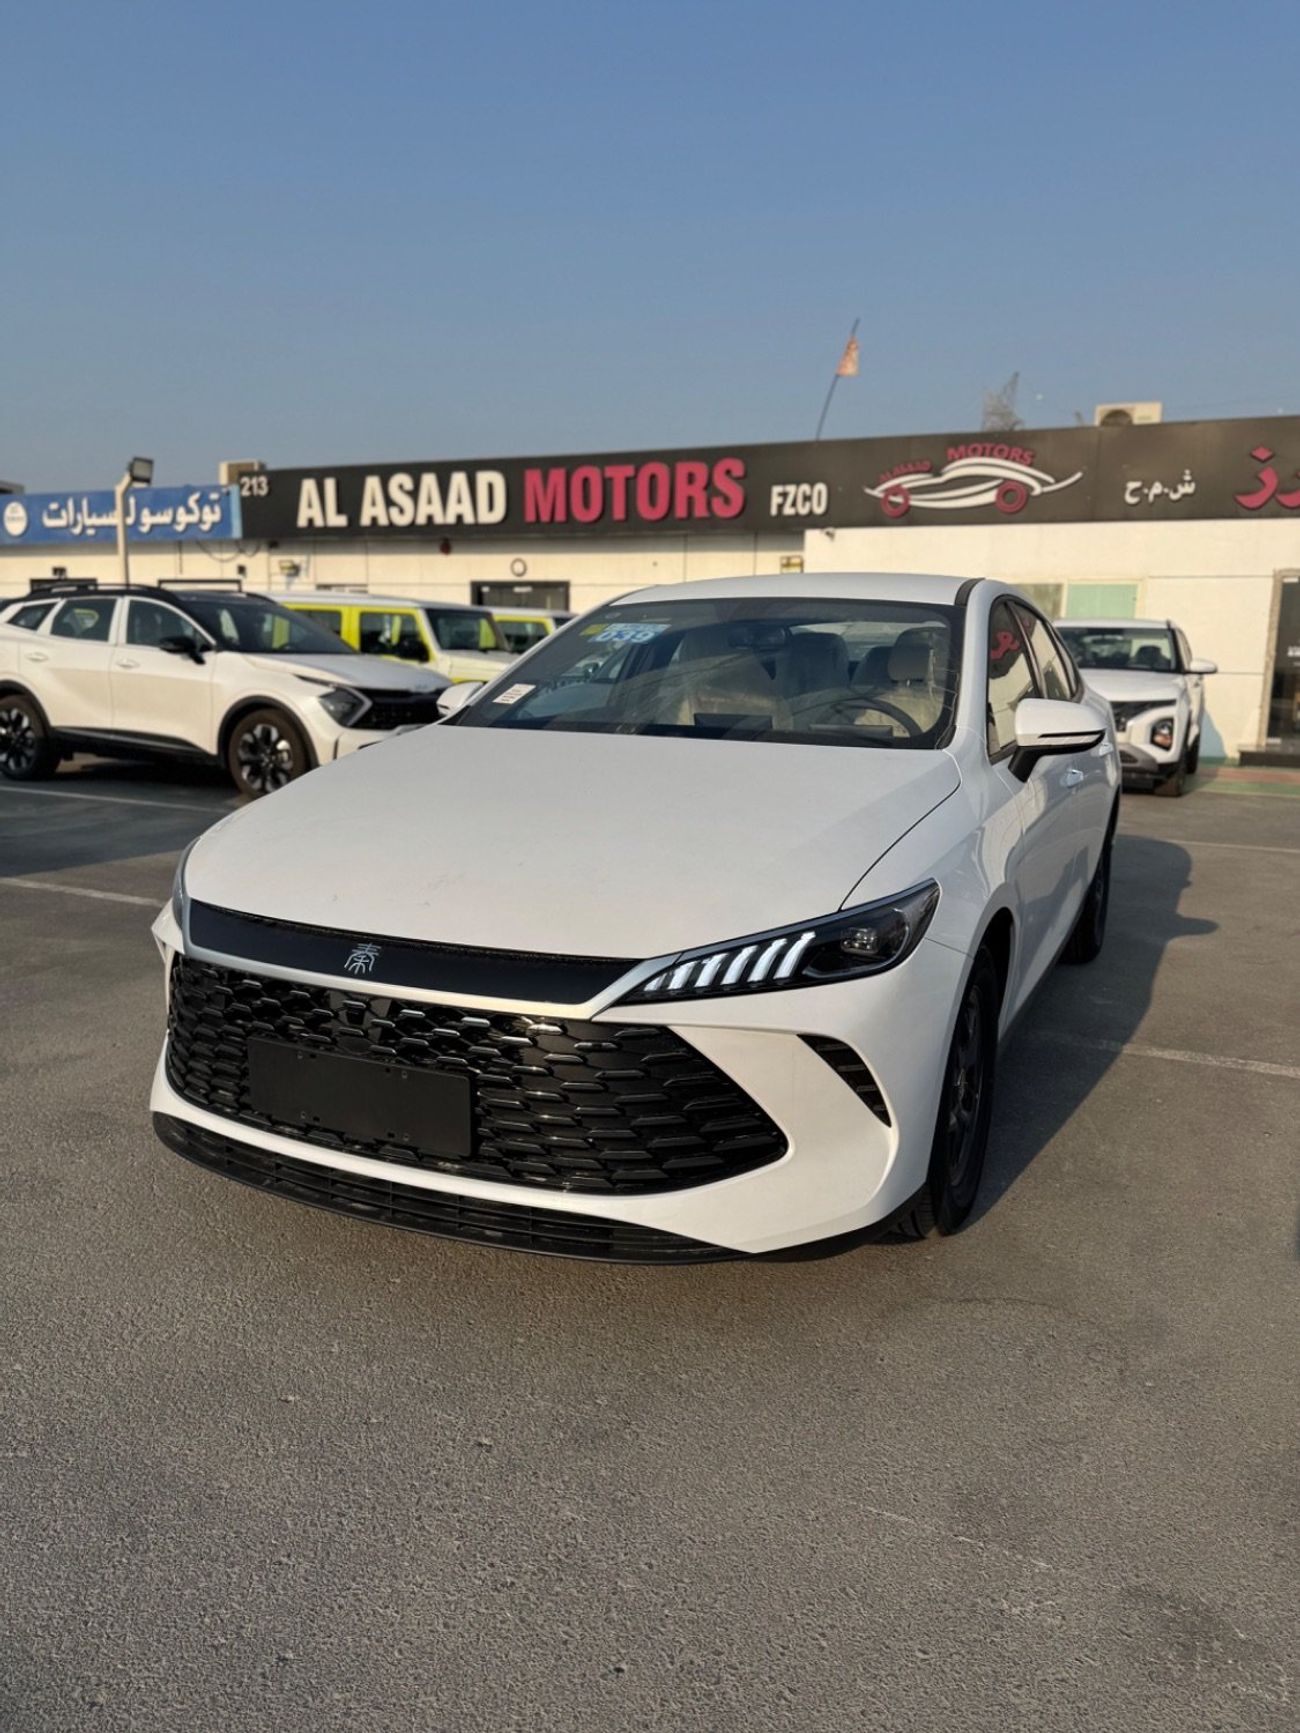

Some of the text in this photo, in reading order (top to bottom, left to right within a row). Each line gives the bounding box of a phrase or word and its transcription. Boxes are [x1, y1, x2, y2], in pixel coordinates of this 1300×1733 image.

[946, 443, 1034, 466] MOTORS
[240, 475, 269, 497] 213
[297, 458, 828, 528] AL ASAAD MOTORS FZCO
